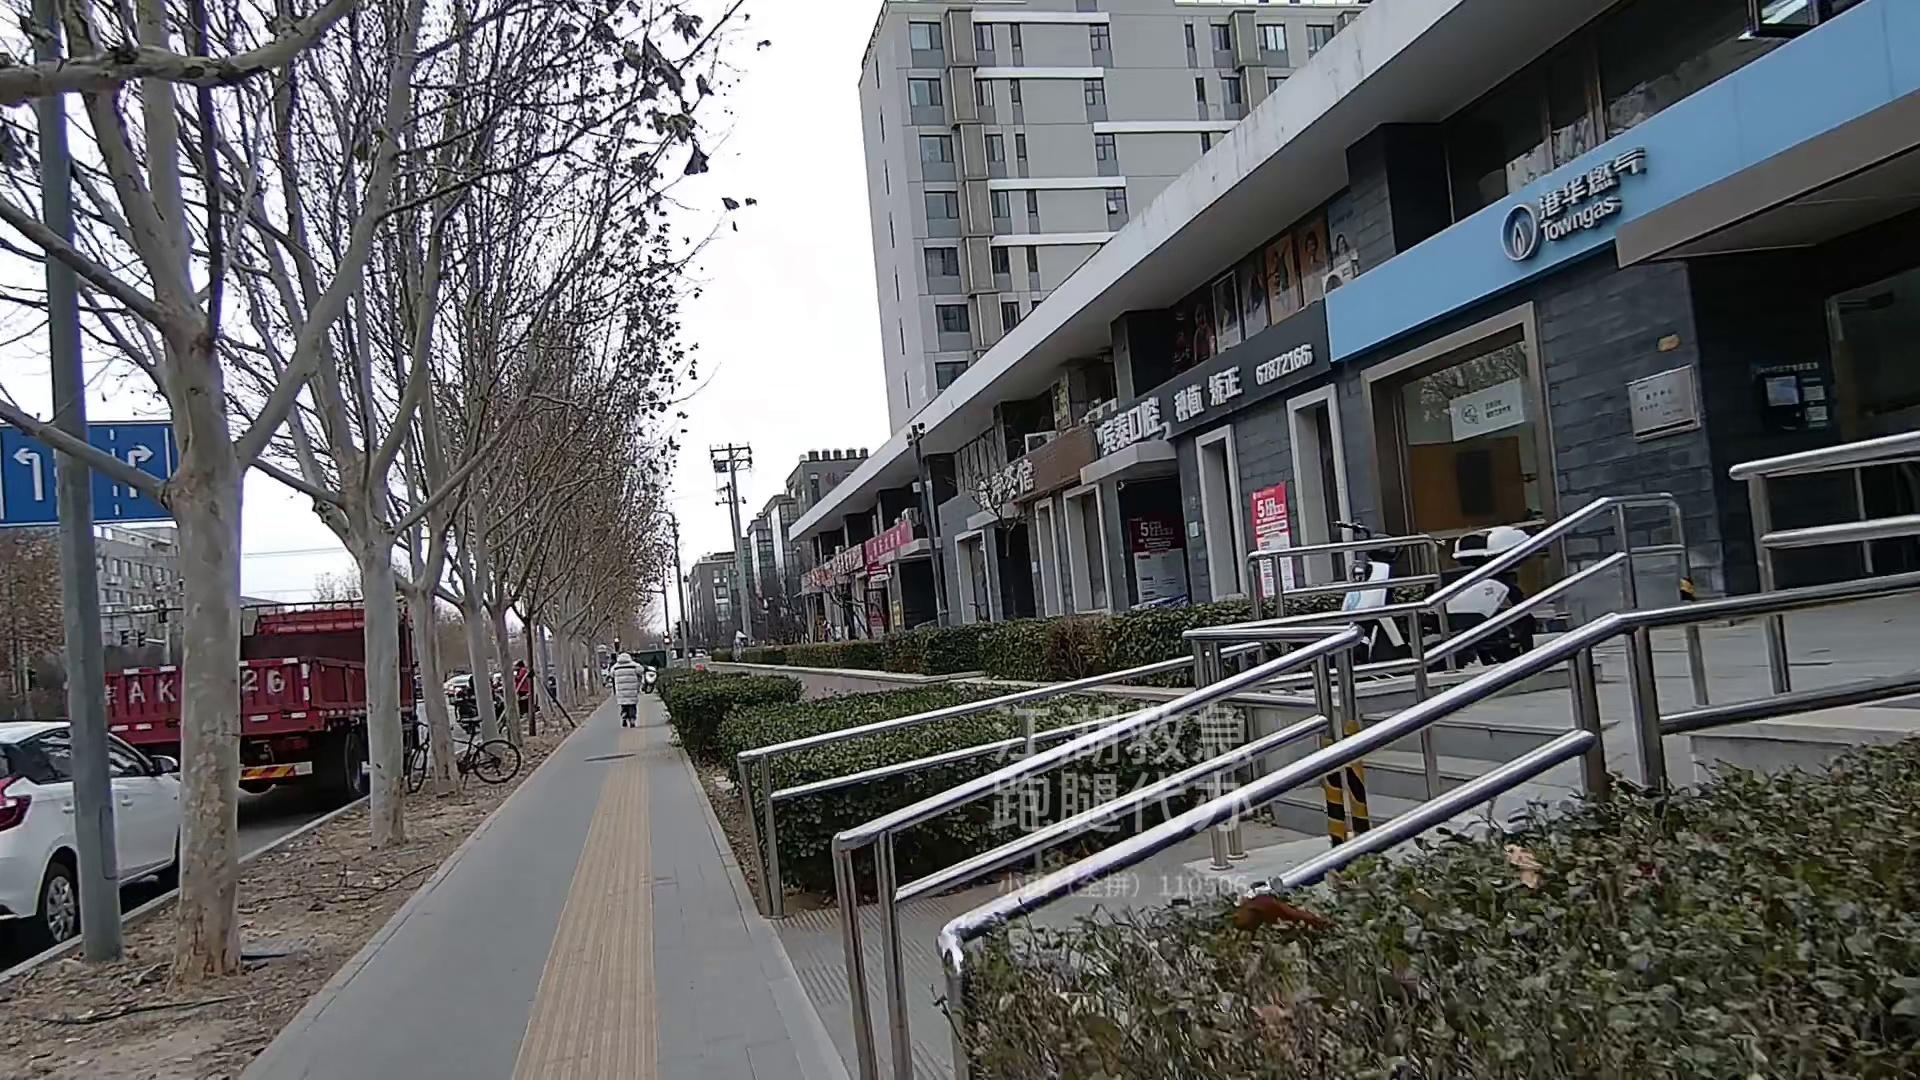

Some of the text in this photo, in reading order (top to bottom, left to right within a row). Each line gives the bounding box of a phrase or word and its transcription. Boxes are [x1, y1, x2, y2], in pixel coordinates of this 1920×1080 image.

[1539, 147, 1646, 220] 港华燃气
[1541, 196, 1621, 242] Towngas
[1174, 384, 1205, 423] 种植
[1208, 366, 1243, 406] 矫正
[1255, 343, 1313, 386] 67872166
